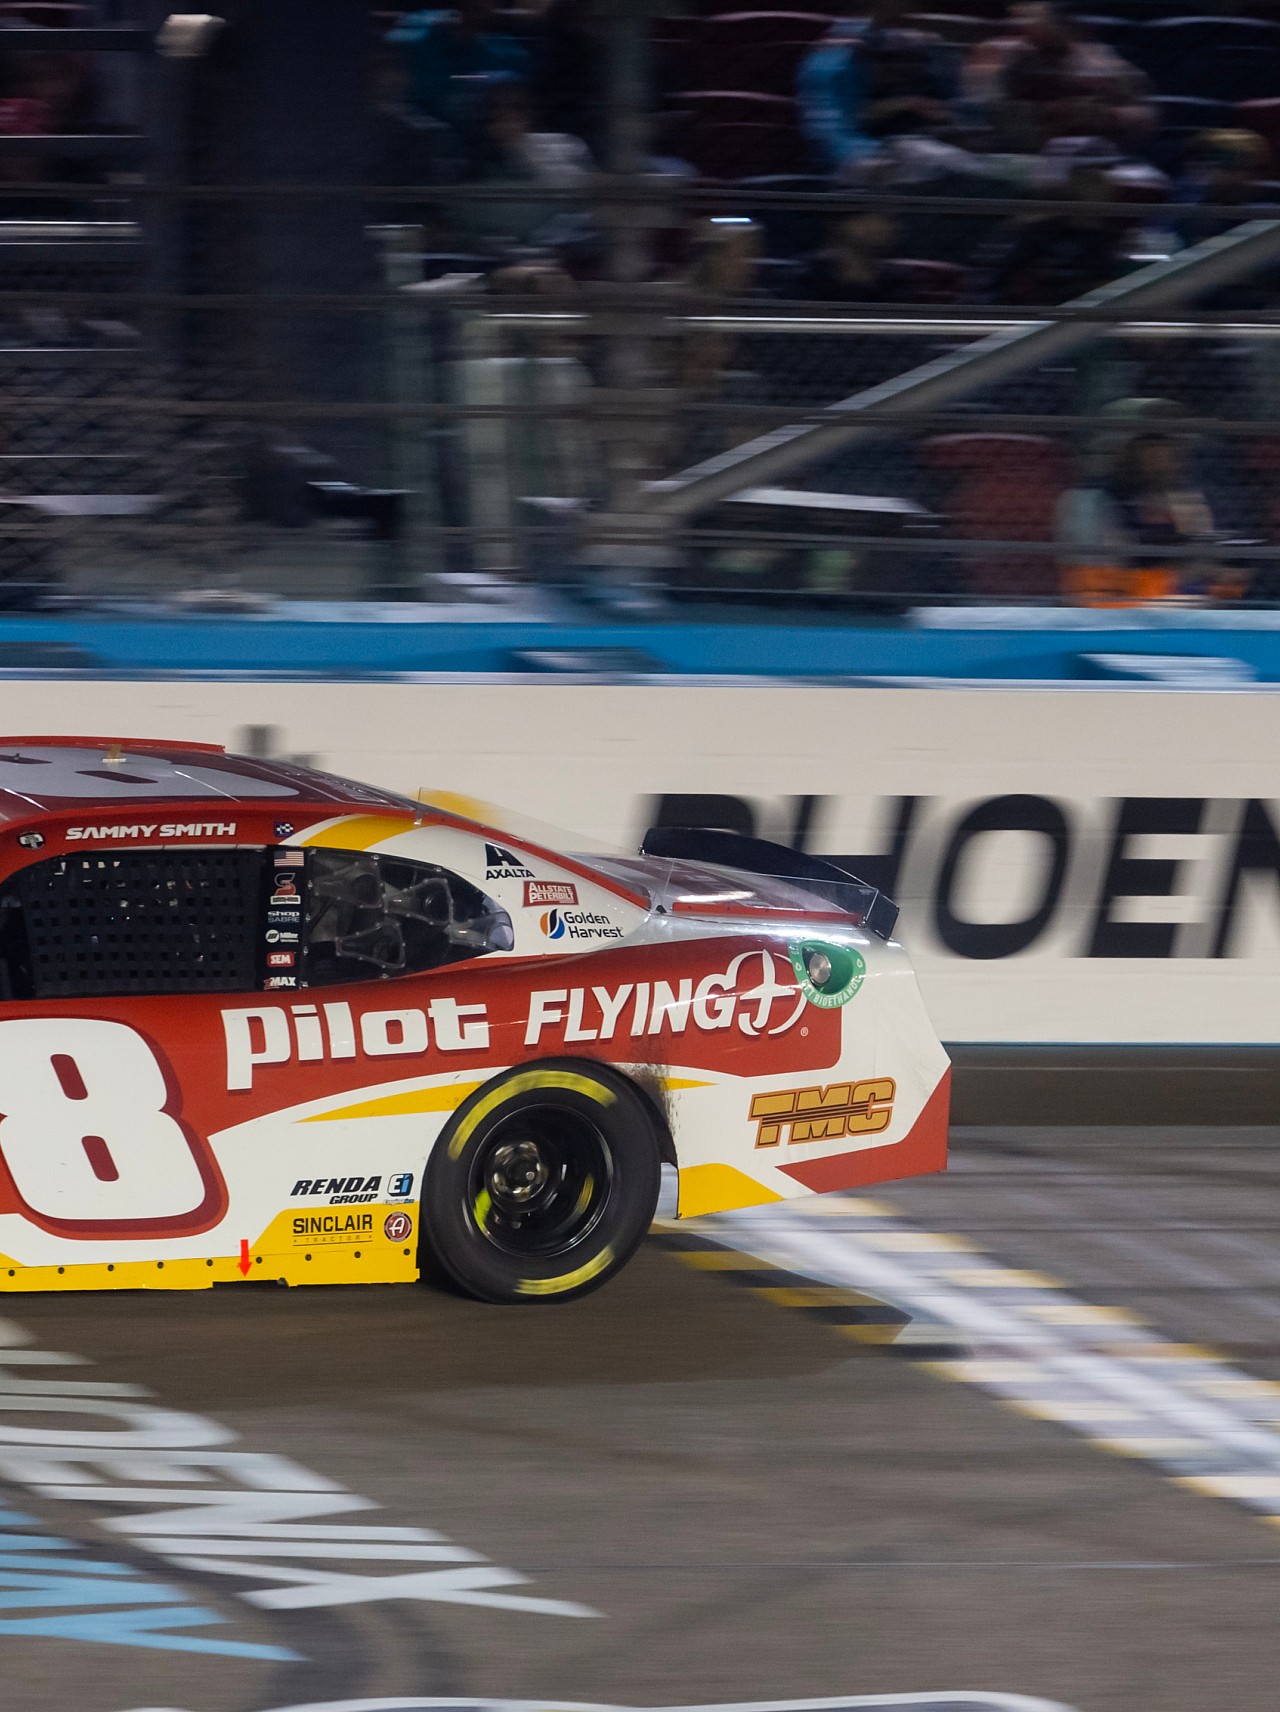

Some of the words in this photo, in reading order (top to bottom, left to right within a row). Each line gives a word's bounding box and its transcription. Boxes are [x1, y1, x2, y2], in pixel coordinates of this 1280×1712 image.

[65, 823, 157, 841] SAMMY
[159, 822, 236, 839] SMITH
[486, 869, 535, 880] AXALTA
[529, 882, 572, 894] ALLSTATE
[564, 912, 610, 924] Golden
[570, 926, 624, 938] Harvest
[270, 954, 291, 965] SEM
[524, 973, 734, 1046] FLYING
[748, 1077, 896, 1149] TMC
[290, 1176, 382, 1196] RENDA
[329, 1193, 378, 1204] GROUP
[293, 1214, 373, 1233] SINCLAIR
